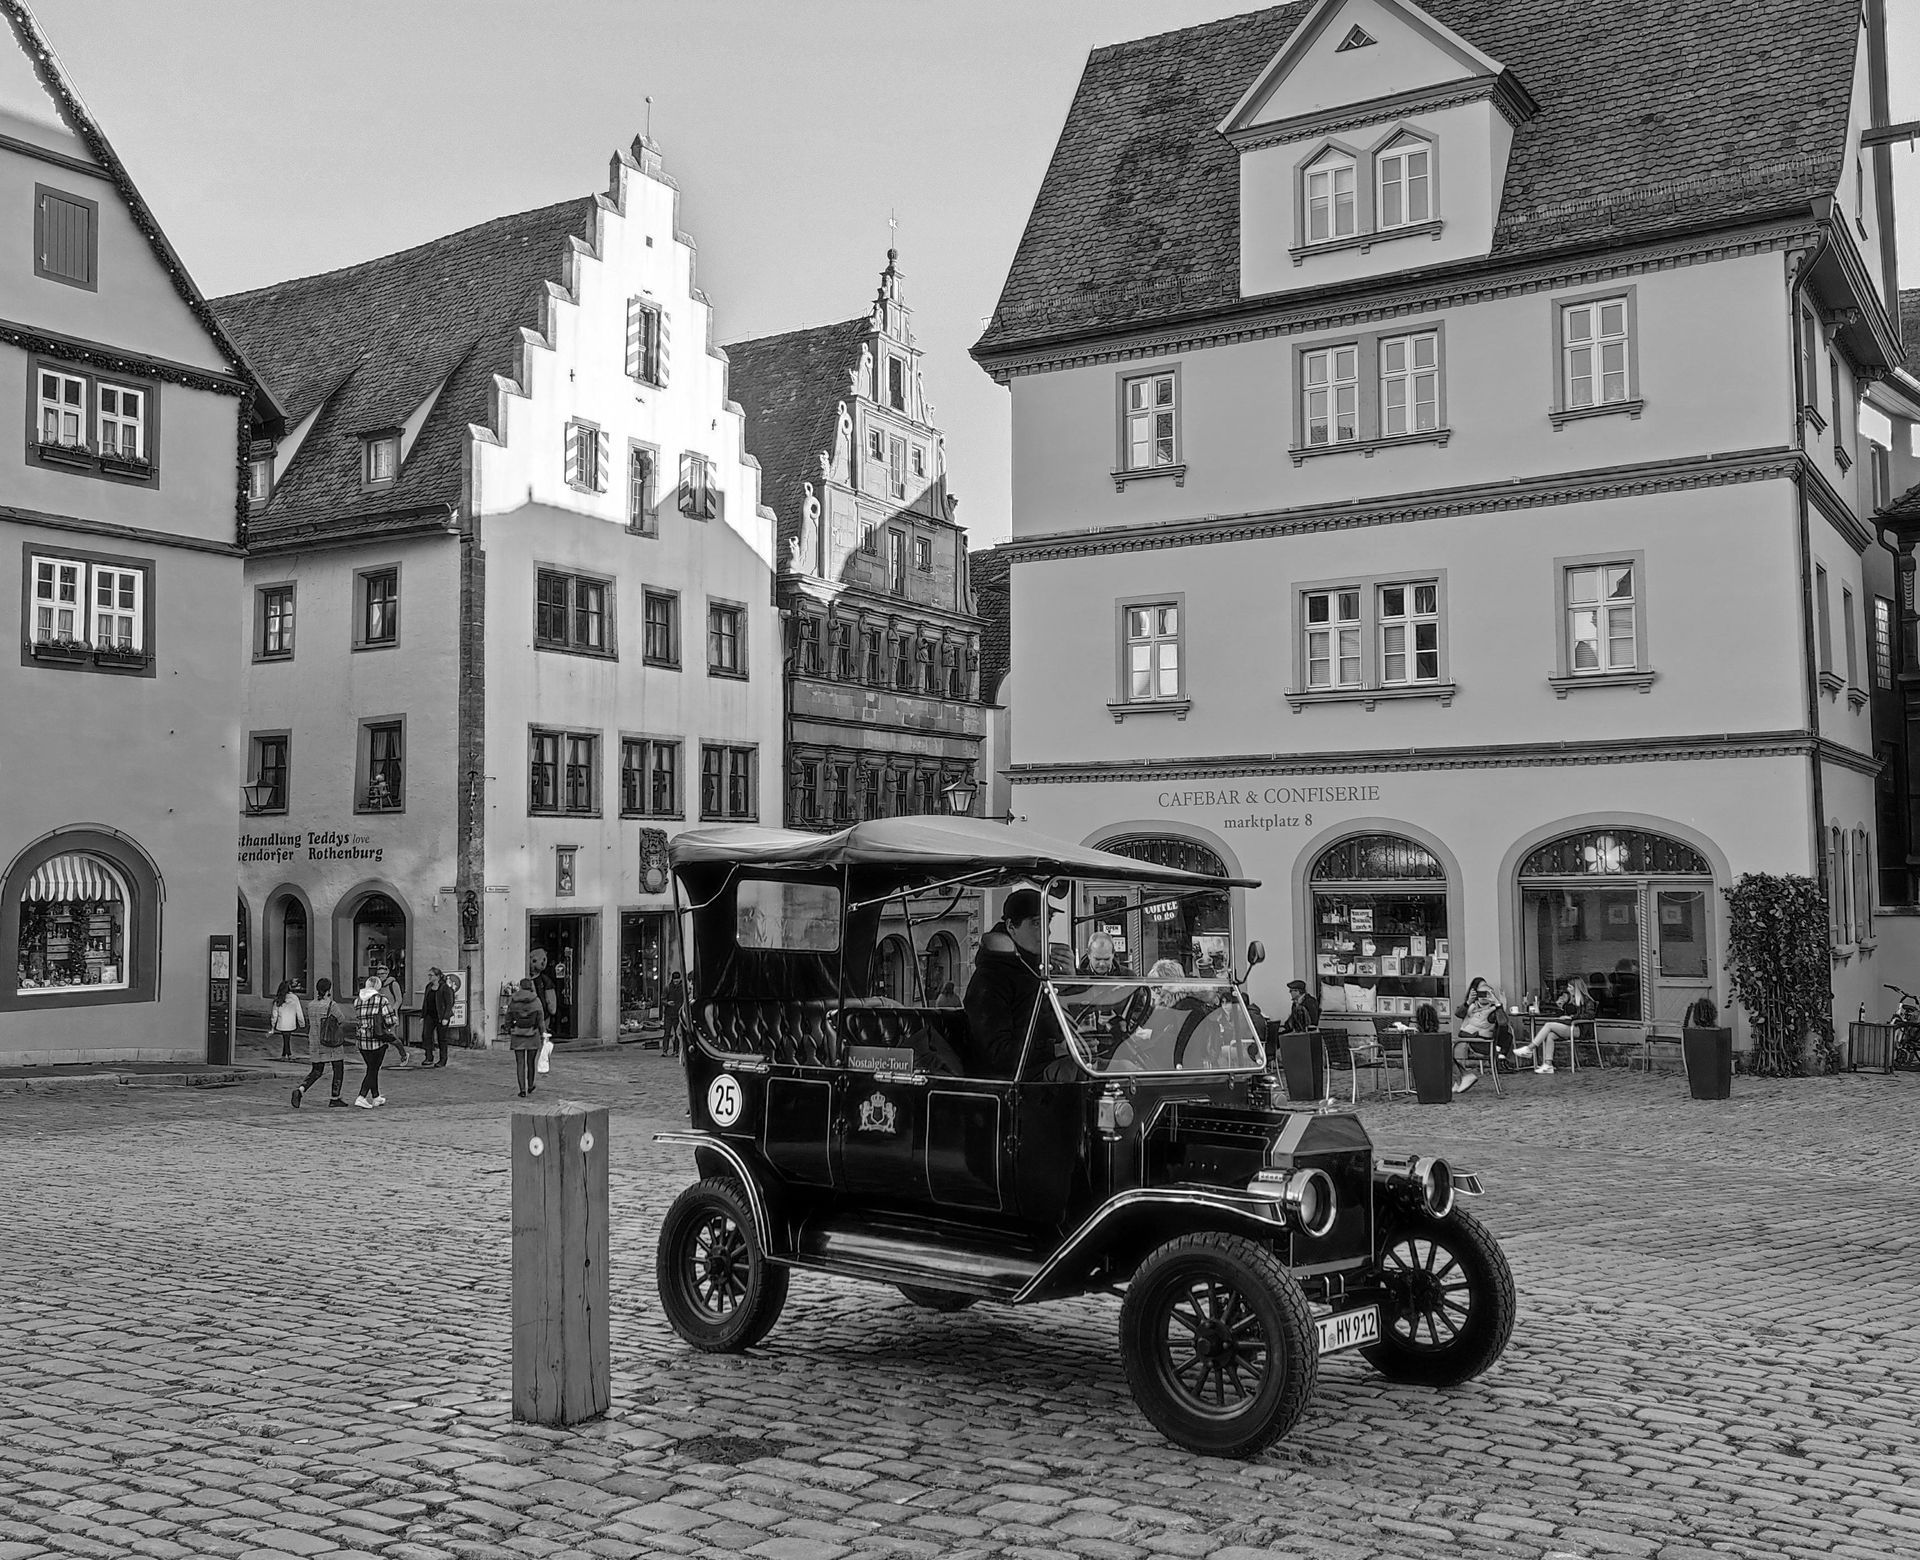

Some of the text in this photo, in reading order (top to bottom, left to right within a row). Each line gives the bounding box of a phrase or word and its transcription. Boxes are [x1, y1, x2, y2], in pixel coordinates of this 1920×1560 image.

[1158, 785, 1380, 808] CAFEBAR & CONFISERIE
[1224, 813, 1313, 831] marktplatz 8
[308, 831, 370, 847] Teddys love
[308, 846, 383, 862] Rothenburg
[848, 1055, 909, 1071] Nostalgie-Tour
[715, 1084, 735, 1116] 25
